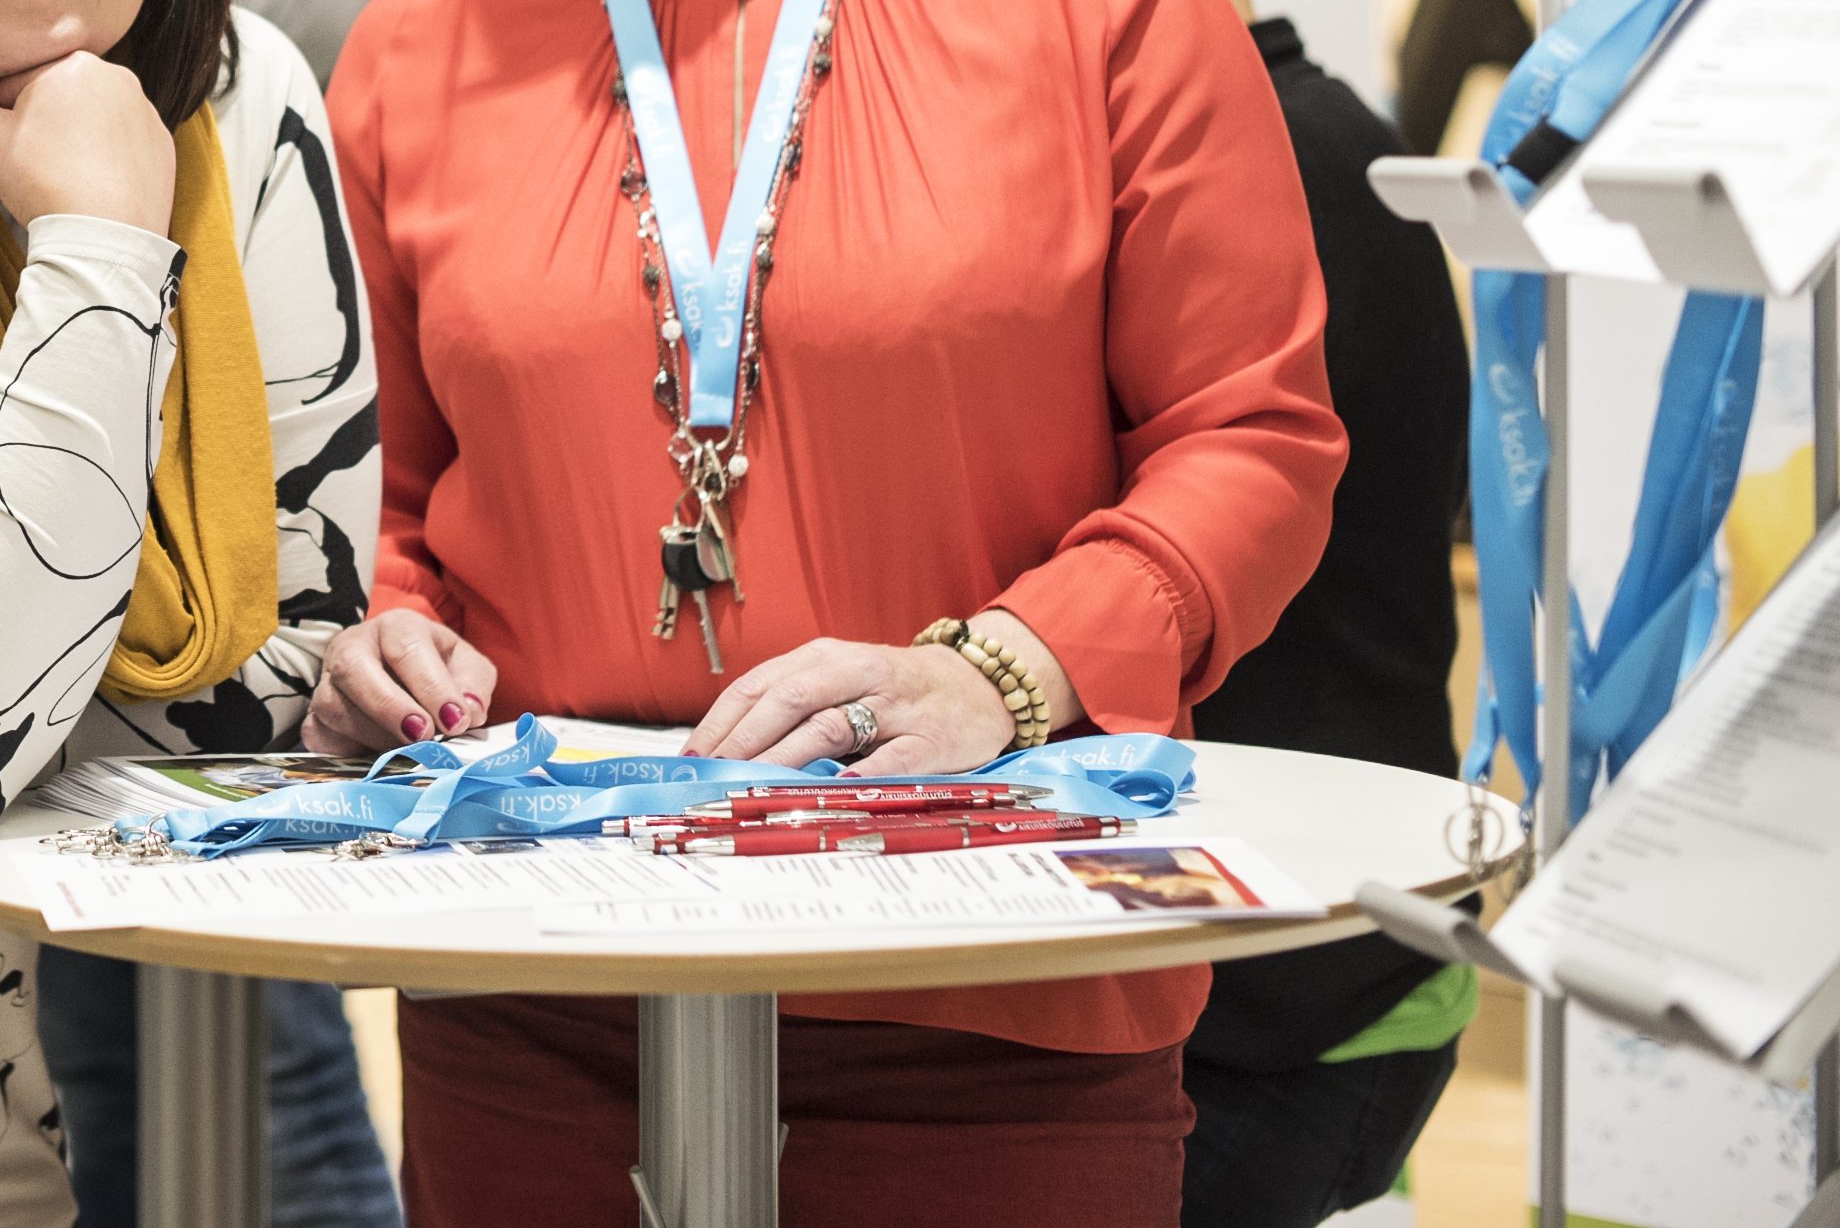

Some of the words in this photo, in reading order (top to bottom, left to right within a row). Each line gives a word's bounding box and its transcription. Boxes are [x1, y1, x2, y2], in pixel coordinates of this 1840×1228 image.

[715, 240, 749, 312] ksak.fi
[295, 792, 374, 821] ksak.fi
[880, 791, 953, 801] AIKUISKOULUTUS
